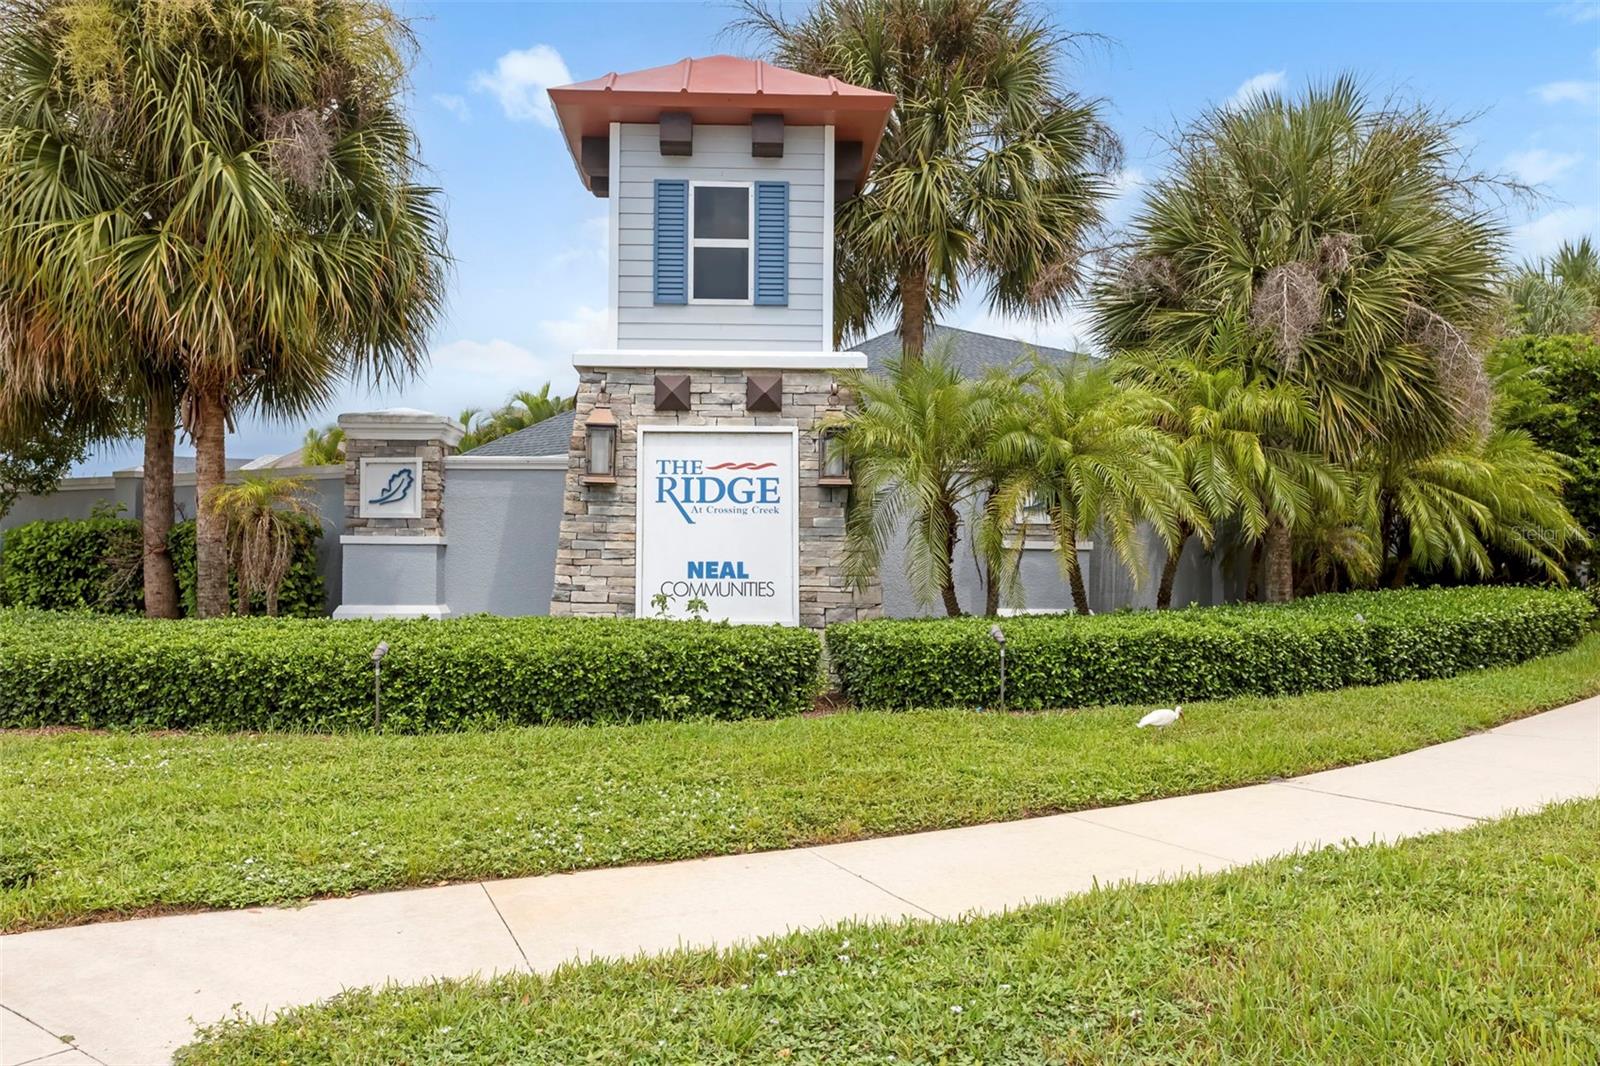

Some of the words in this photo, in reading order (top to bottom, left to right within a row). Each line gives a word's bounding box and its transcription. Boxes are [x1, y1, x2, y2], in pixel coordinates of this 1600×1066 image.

[656, 459, 703, 475] THE
[655, 476, 781, 525] RIDGE
[691, 506, 703, 515] At
[706, 505, 748, 516] Crossing
[751, 505, 780, 515] Creek
[687, 561, 749, 579] NEAL
[660, 581, 775, 598] COMMUNITIES
